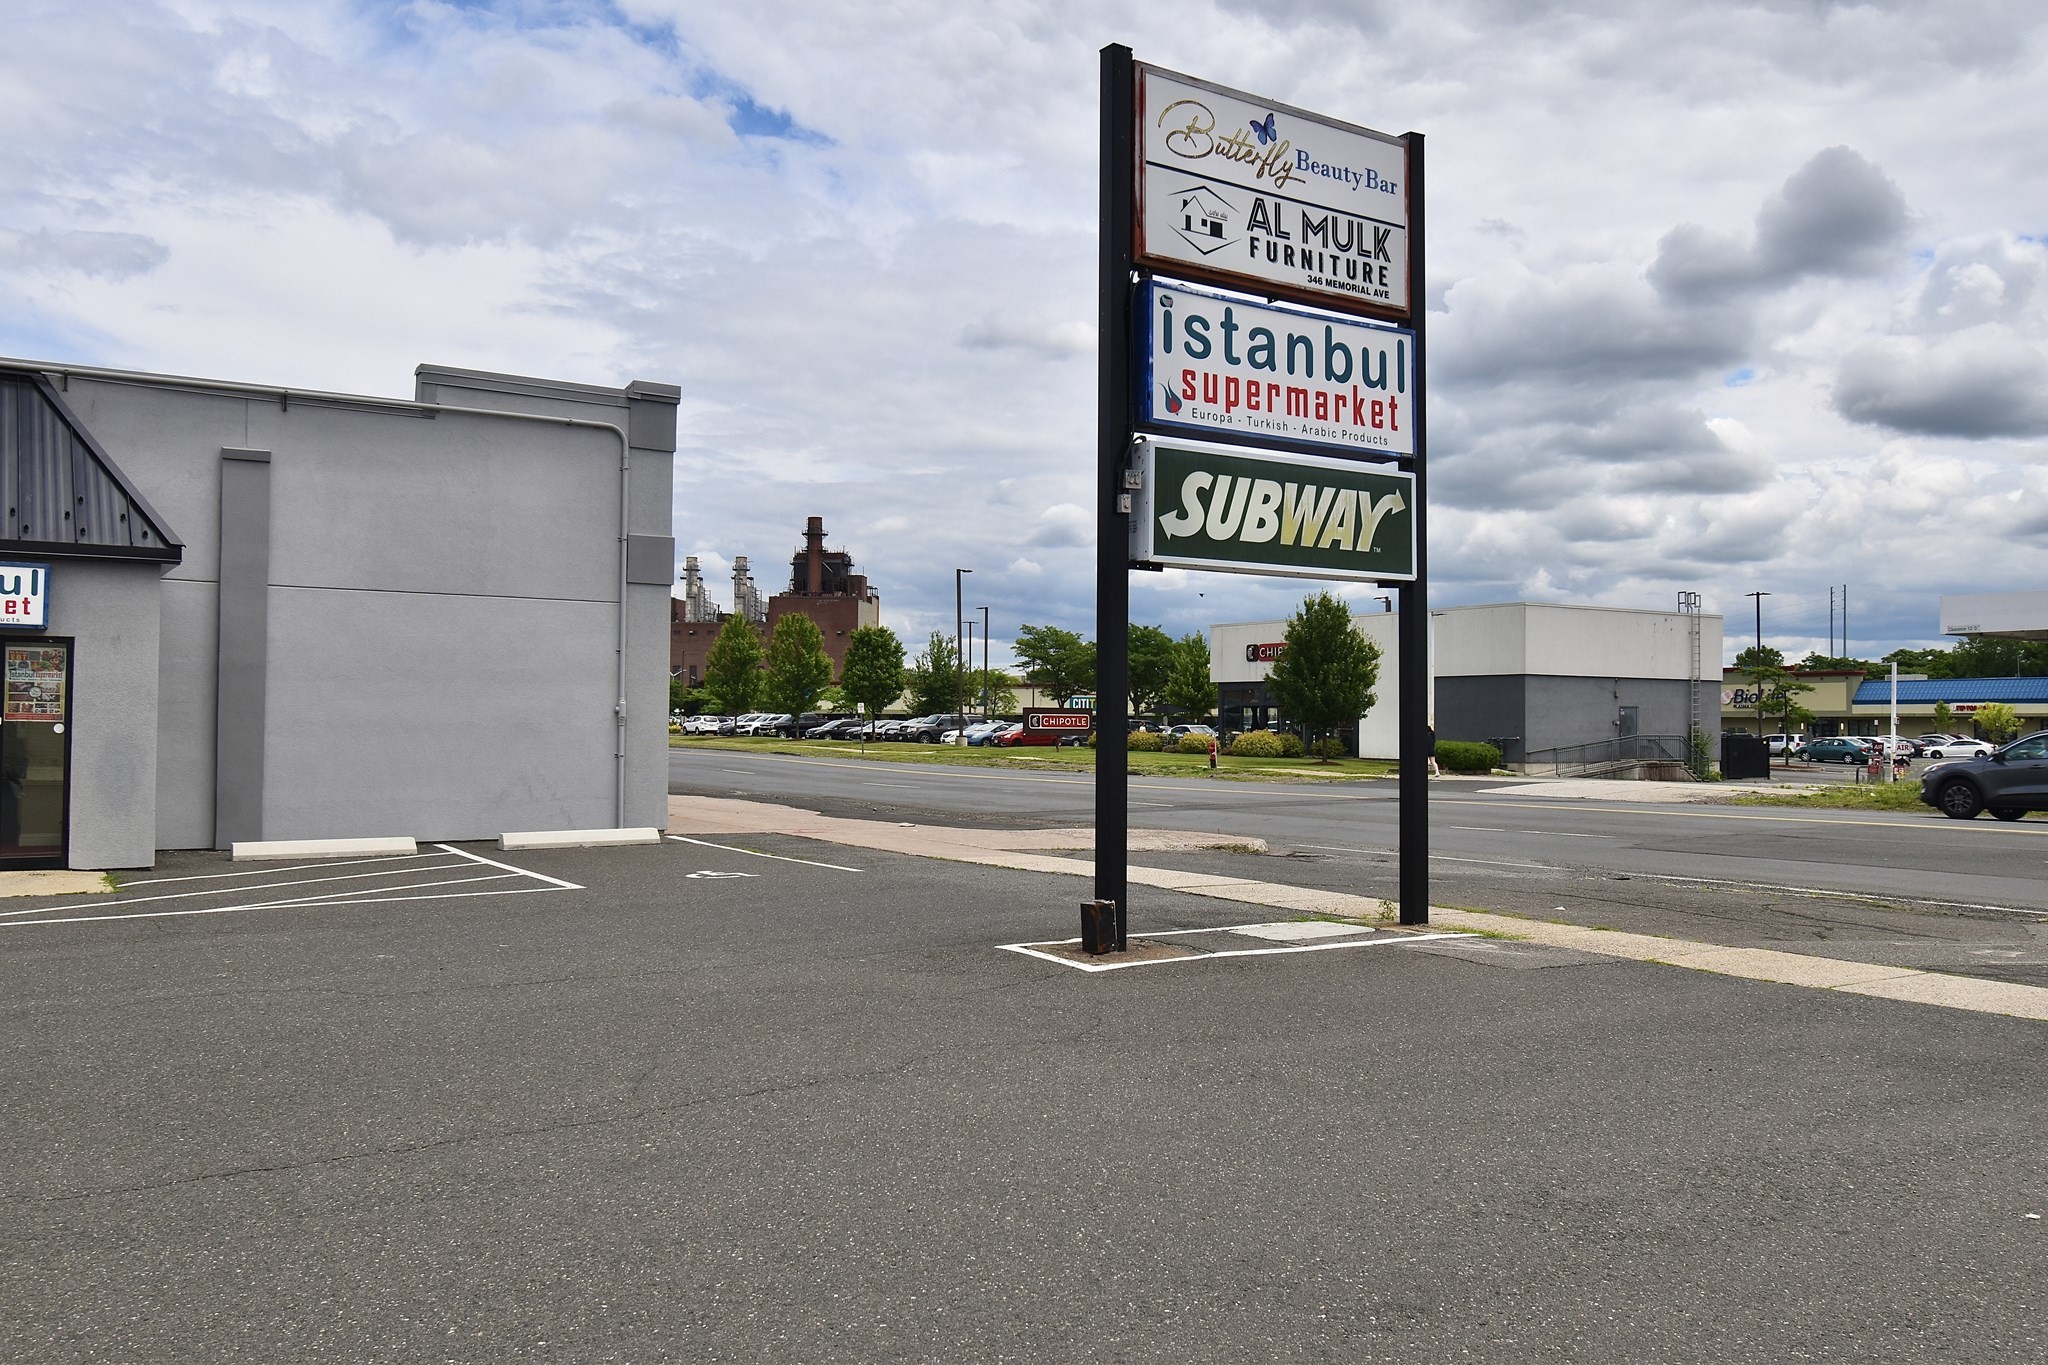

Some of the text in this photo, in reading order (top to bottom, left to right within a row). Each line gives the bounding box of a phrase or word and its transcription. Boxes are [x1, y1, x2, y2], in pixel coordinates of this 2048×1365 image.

[1158, 99, 1398, 195] Butterfly Beauty Bar
[1247, 197, 1392, 264] AL MULK
[1249, 236, 1389, 288] FURNITURE
[1307, 274, 1390, 300] 346 MEMORIAL AVE
[1181, 368, 1399, 432] supermarket
[1191, 407, 1233, 425] Europa
[1246, 415, 1289, 432] Turkish
[1301, 423, 1338, 439] Arabic
[1341, 430, 1389, 446] Products
[1158, 470, 1406, 553] SUBWAY
[1259, 645, 1283, 658] CHIP
[1043, 717, 1087, 726] CHIPOTLE
[1072, 698, 1096, 709] CITIT
